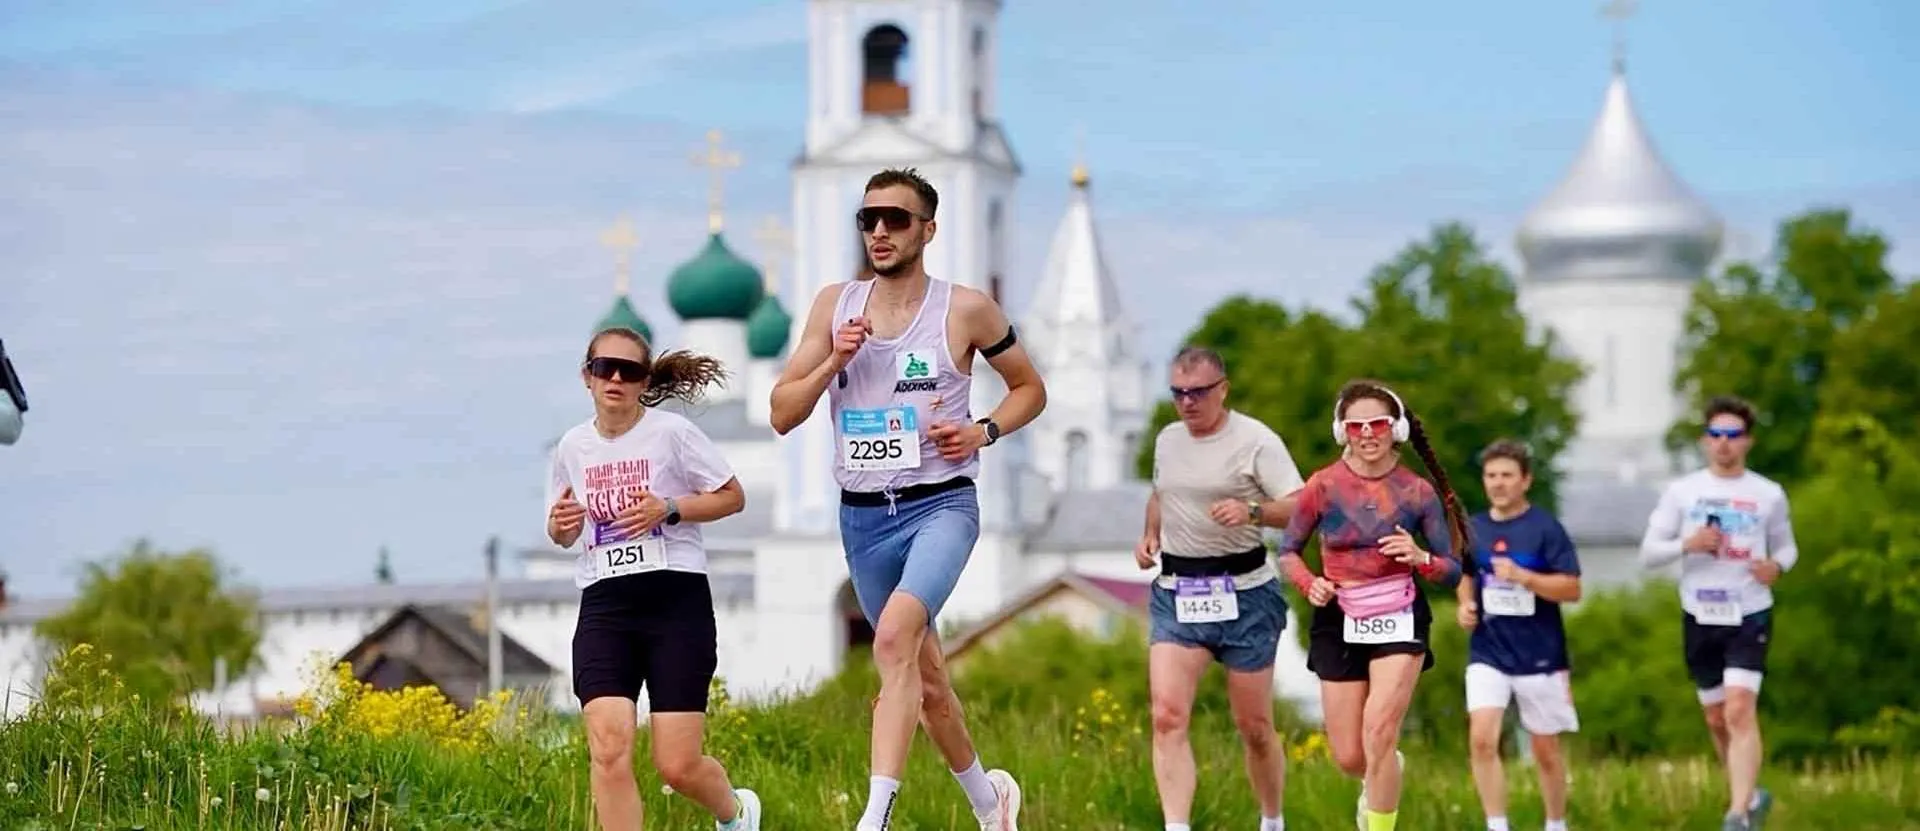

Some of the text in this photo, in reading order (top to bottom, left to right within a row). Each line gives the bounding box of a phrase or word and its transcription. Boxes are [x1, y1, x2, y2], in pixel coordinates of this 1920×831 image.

[894, 381, 938, 394] ADIXION
[849, 438, 903, 460] 2295
[605, 545, 645, 568] 1251
[1182, 599, 1223, 616] 1445
[1353, 618, 1397, 635] 1589
